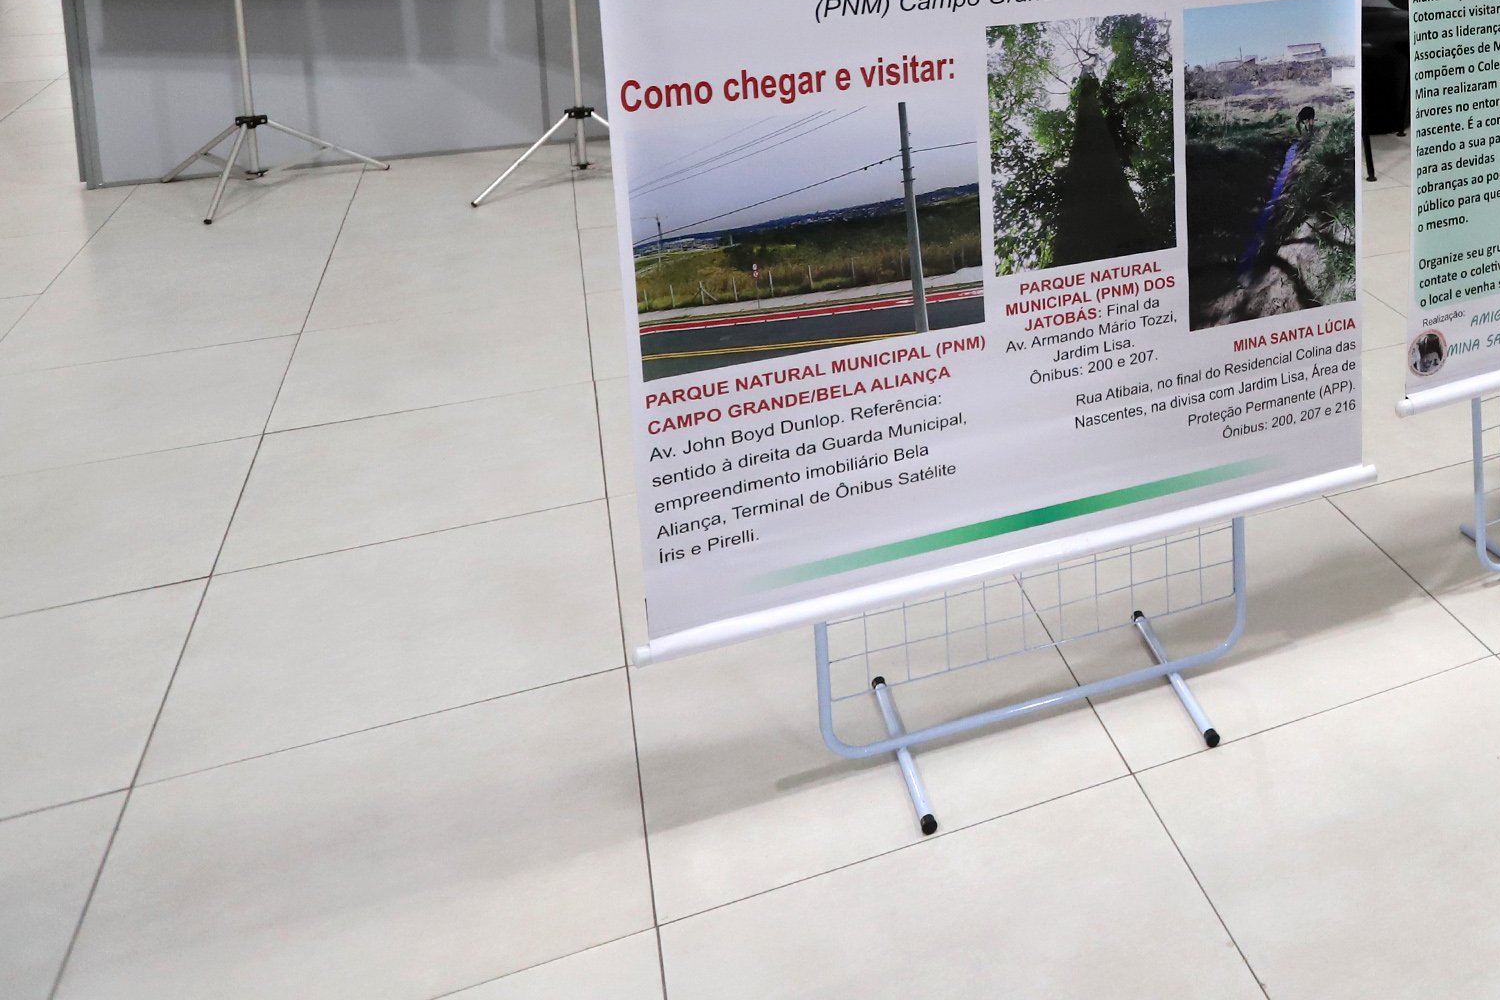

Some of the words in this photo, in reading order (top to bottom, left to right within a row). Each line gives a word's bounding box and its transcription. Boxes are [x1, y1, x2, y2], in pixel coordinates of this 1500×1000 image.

[621, 80, 712, 112] Como
[724, 70, 826, 104] chegar
[836, 69, 851, 90] e
[860, 55, 954, 87] visitar:
[1006, 292, 1092, 316] MUNICIPAL
[1096, 282, 1139, 303] (PNM)
[1144, 276, 1175, 291] DOS
[1020, 274, 1085, 295] PARQUE
[1091, 262, 1161, 283] NATURAL
[1025, 308, 1101, 331] JATOBÁS:
[1107, 300, 1138, 316] Final
[1144, 298, 1159, 309] da
[1423, 311, 1465, 327] Realização:
[1234, 336, 1267, 352] MINA
[1271, 326, 1314, 344] SANTA
[1318, 318, 1355, 335] LÚCIA
[1446, 338, 1480, 357] MINA
[646, 381, 729, 409] PARQUE
[736, 364, 826, 391] NATURAL
[832, 346, 931, 373] MUNICIPAL
[937, 336, 985, 358] (PNM)
[648, 409, 721, 434] CAMPO
[728, 382, 866, 418] GRANDE/BELA
[871, 367, 950, 391] ALIANÇA
[650, 447, 675, 462] Av.
[683, 437, 724, 454] John
[732, 423, 774, 444] Boyd
[781, 414, 844, 434] Dunlop.
[851, 395, 941, 420] Referência:
